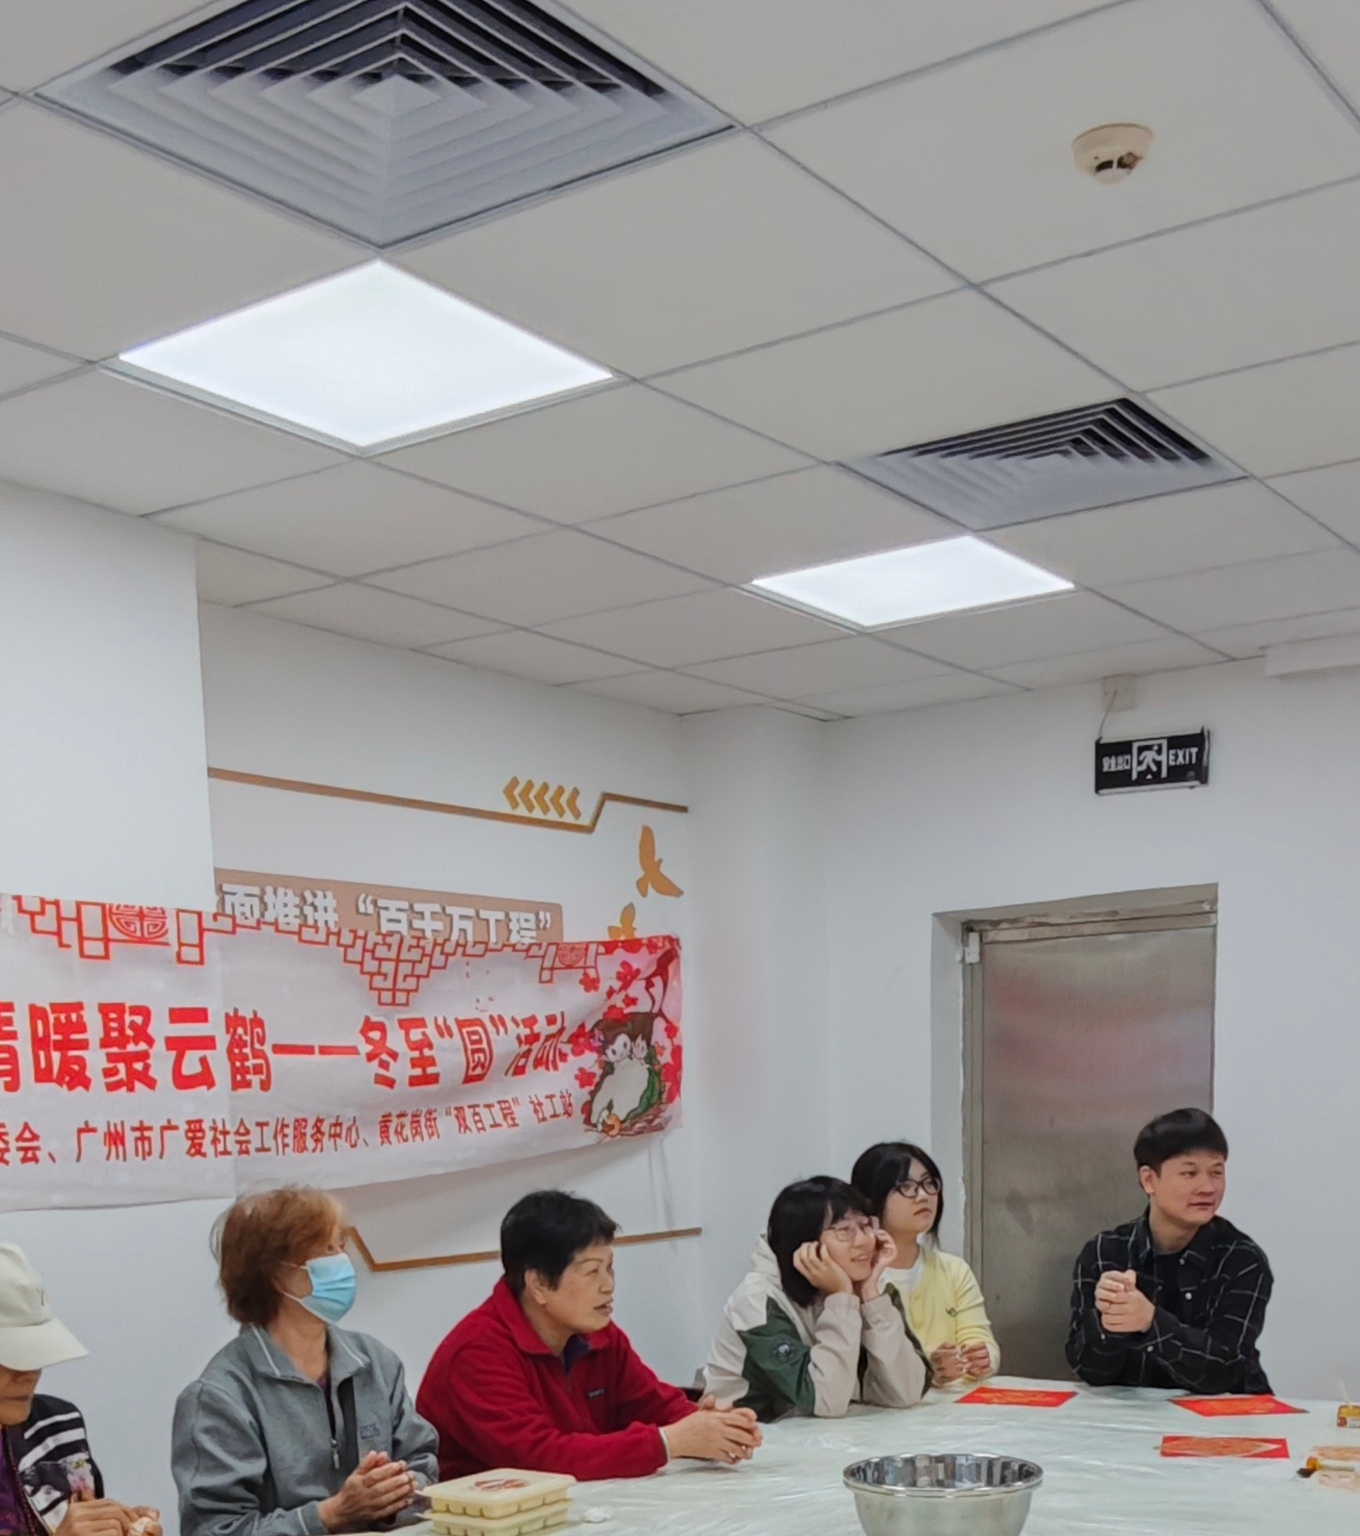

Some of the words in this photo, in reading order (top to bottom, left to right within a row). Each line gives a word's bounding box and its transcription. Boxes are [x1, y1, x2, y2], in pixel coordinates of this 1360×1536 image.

[1168, 747, 1198, 767] EXIT
[216, 882, 552, 948] 面推进“百千万工程”
